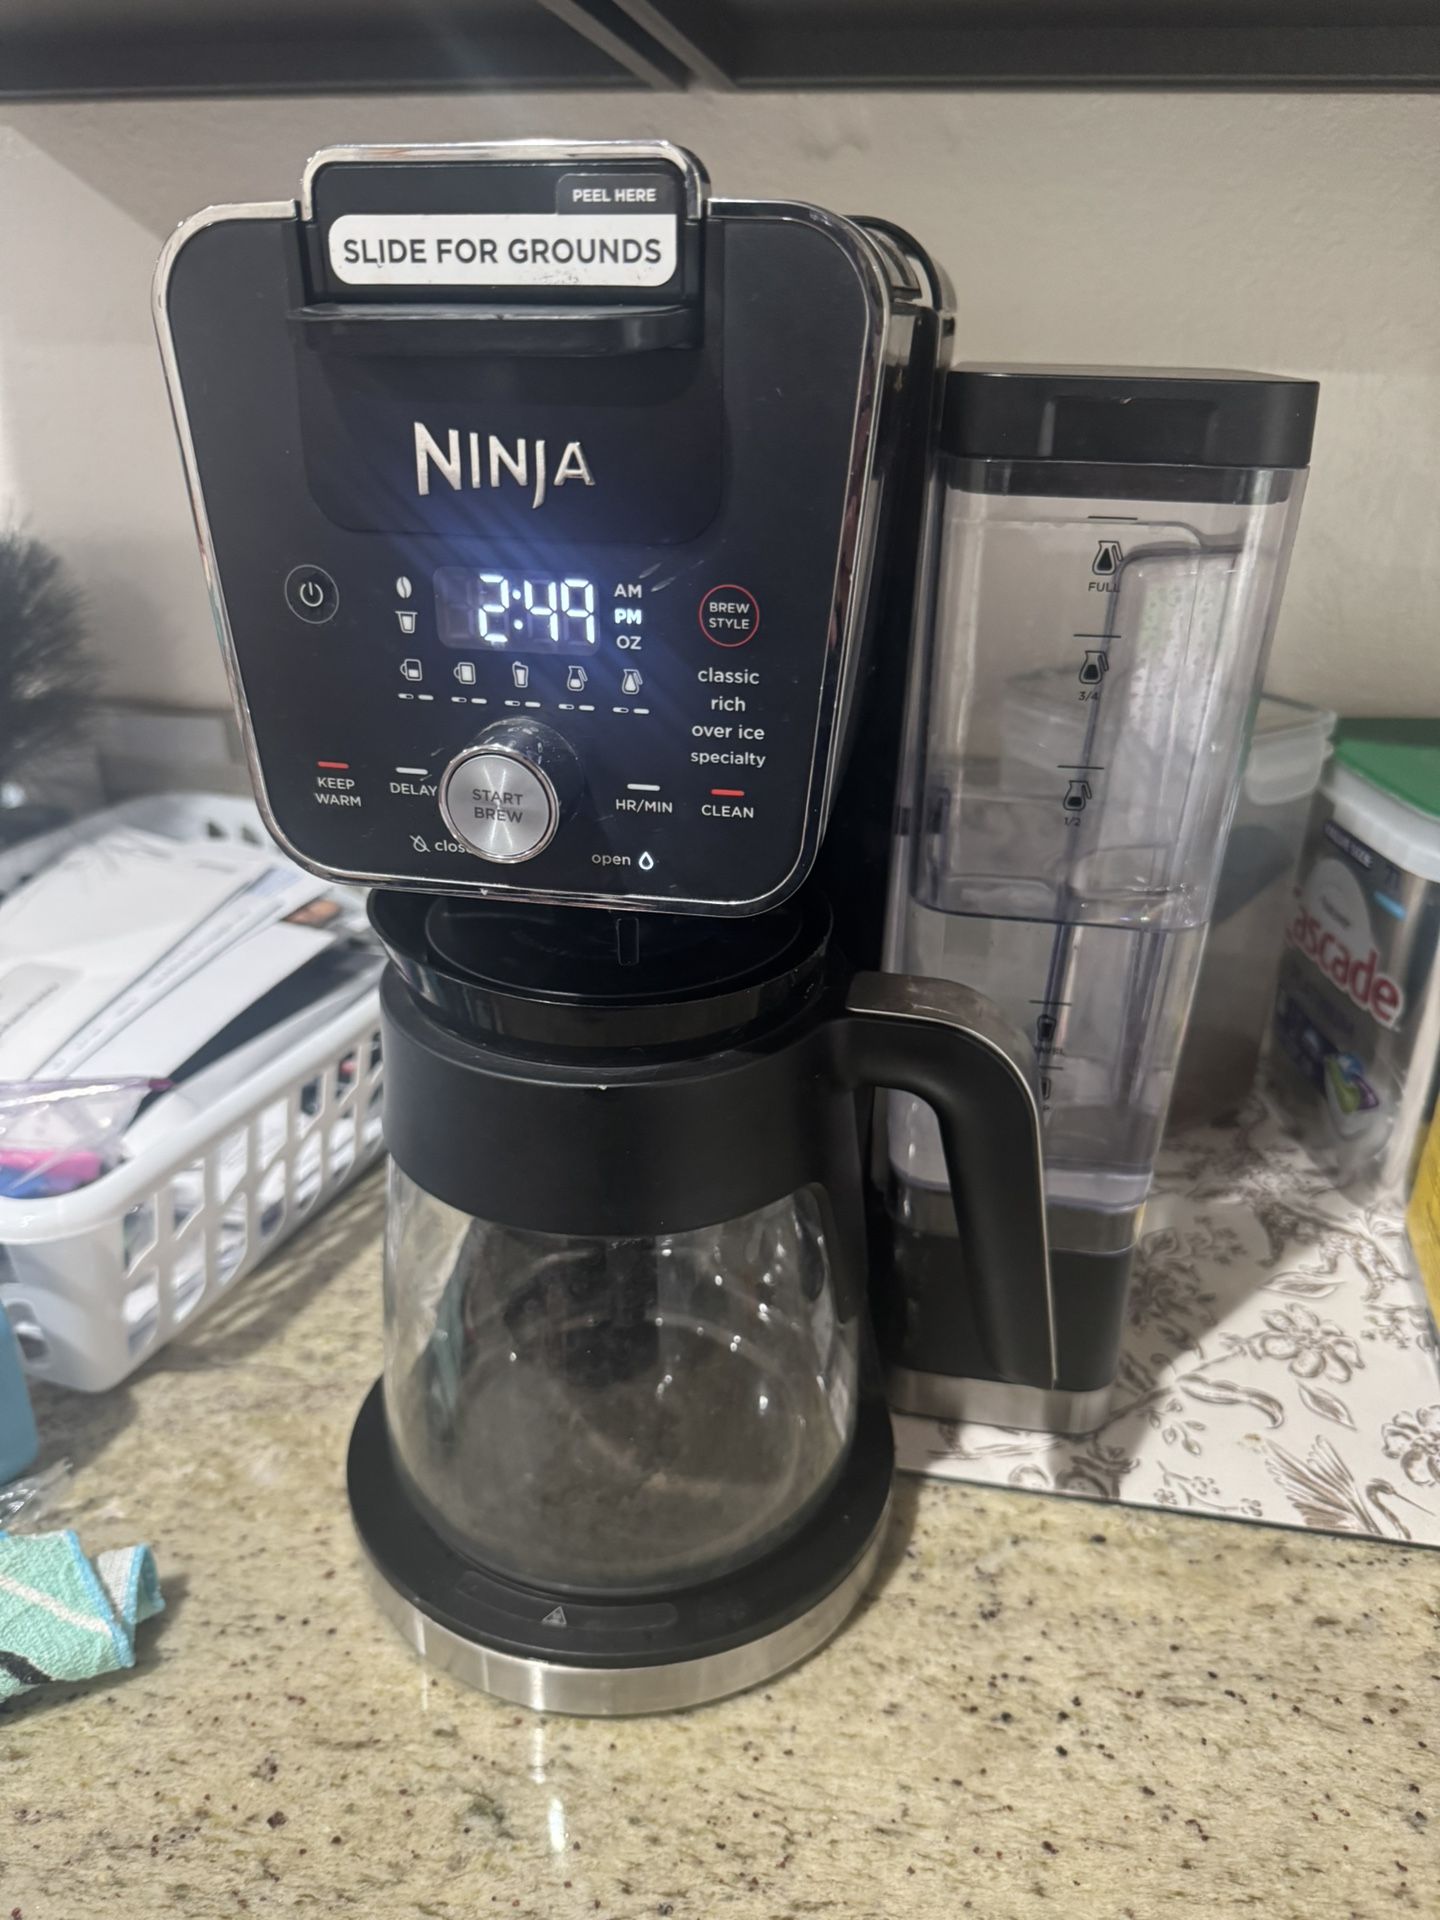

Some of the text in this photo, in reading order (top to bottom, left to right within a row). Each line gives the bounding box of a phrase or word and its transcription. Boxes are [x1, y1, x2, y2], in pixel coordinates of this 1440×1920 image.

[573, 188, 657, 203] PEEL HERE
[344, 238, 662, 264] SLIDE FOR GROUNDS
[414, 421, 596, 509] NINJA
[614, 584, 642, 599] AM
[1088, 582, 1120, 593] FULL
[477, 573, 596, 645] 2:49
[709, 602, 750, 615] BREW
[614, 609, 642, 625] PM
[708, 617, 750, 630] STYLE
[616, 635, 642, 650] OZ
[697, 667, 760, 684] classic
[1078, 691, 1099, 701] 3/4
[710, 696, 746, 712] rich
[691, 724, 765, 740] over ice
[690, 751, 766, 768] specialty
[317, 777, 356, 791] KEEP
[389, 782, 438, 798] DELAY
[314, 793, 362, 808] WARM
[472, 788, 524, 806] START
[615, 799, 673, 814] HR/MIN
[700, 804, 755, 819] CLEAN
[473, 806, 524, 824] BREW
[434, 839, 468, 854] clos
[591, 853, 631, 867] open
